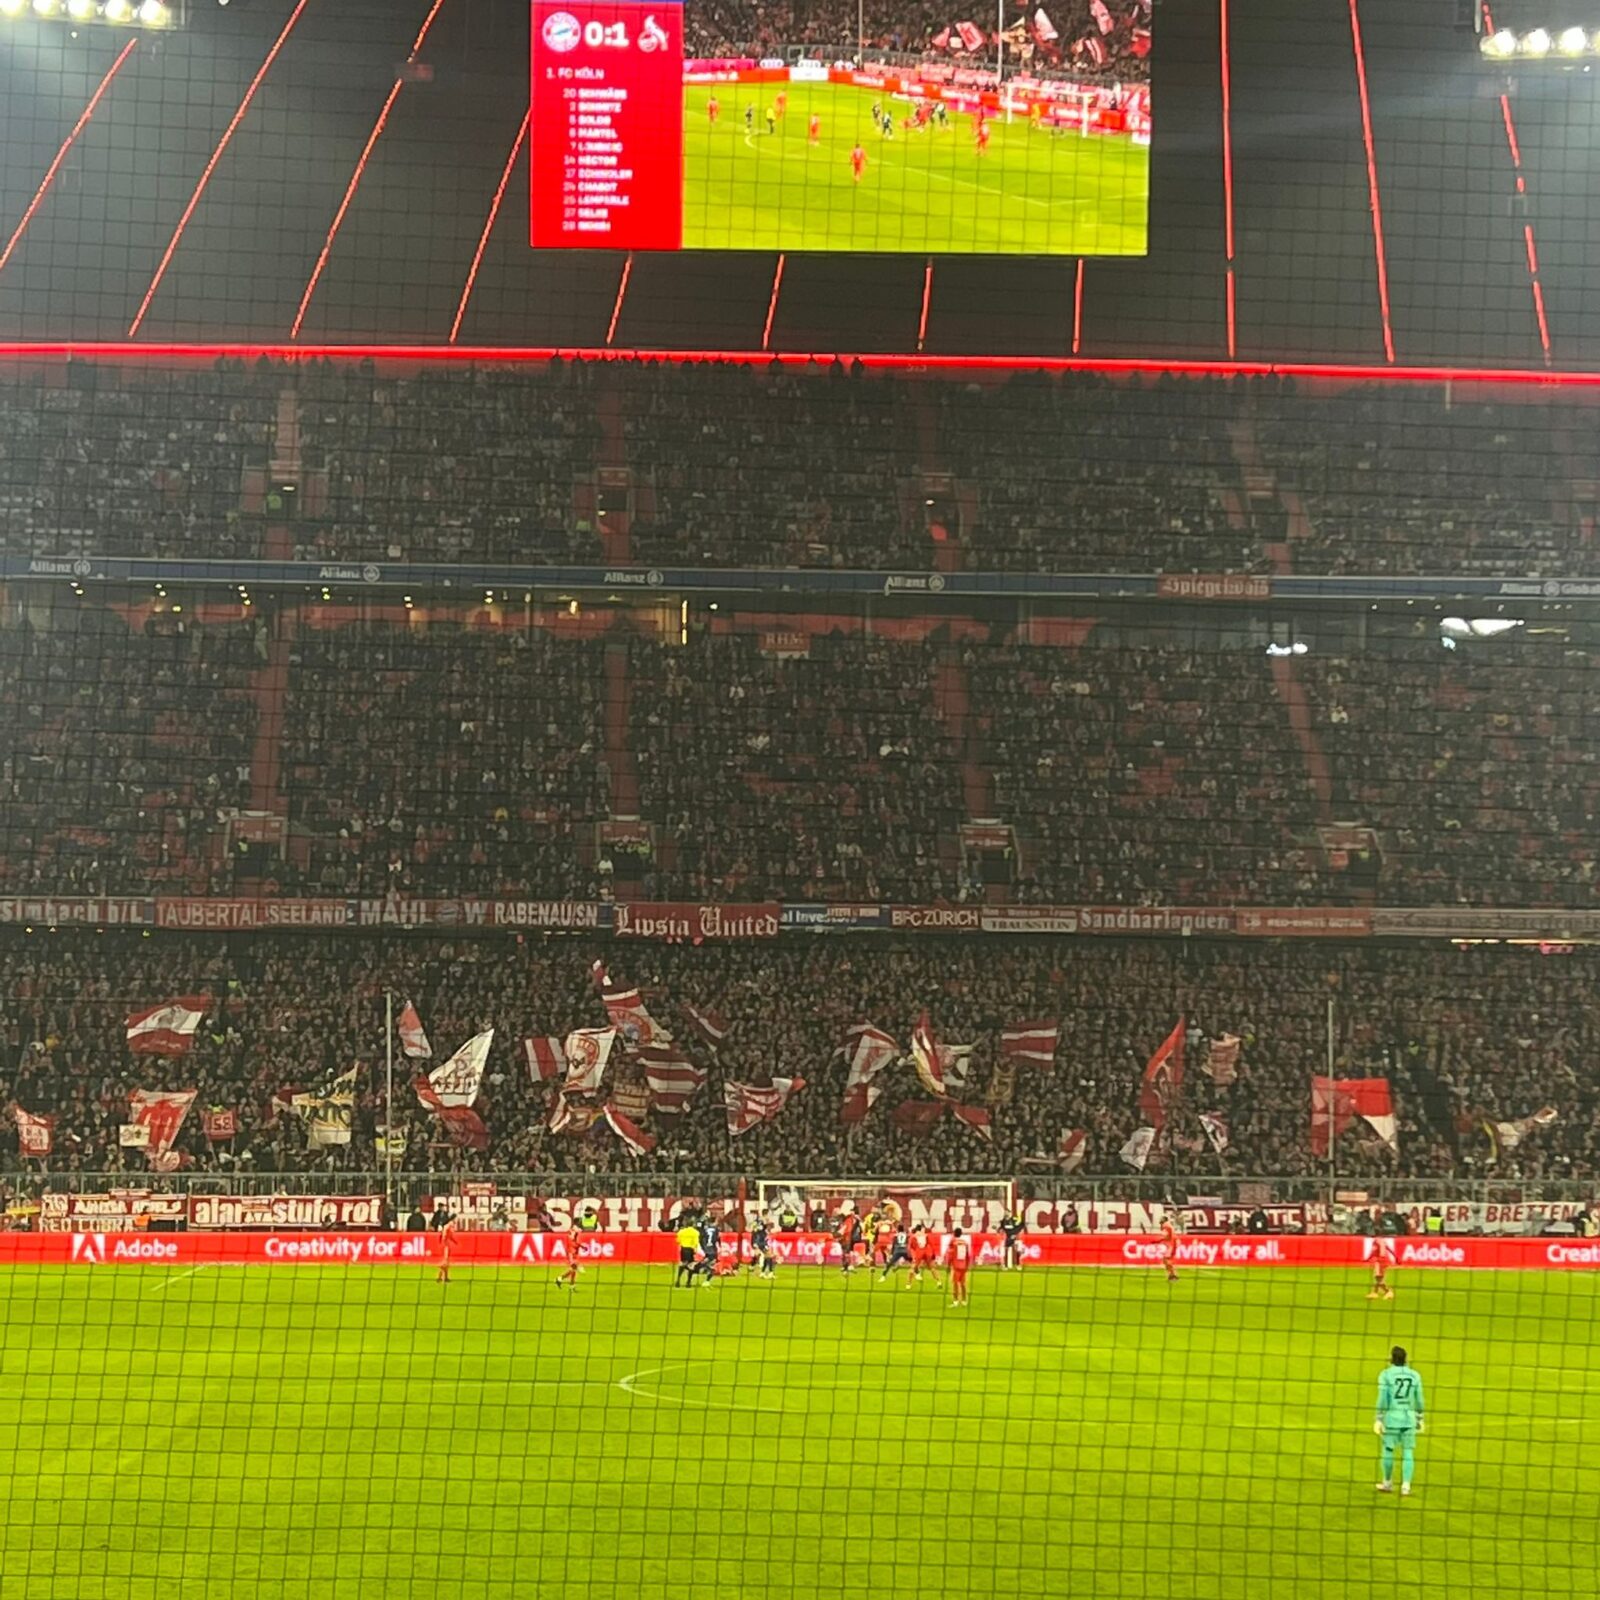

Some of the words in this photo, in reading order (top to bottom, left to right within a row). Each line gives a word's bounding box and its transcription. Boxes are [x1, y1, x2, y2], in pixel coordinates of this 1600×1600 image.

[584, 20, 630, 47] 0:1
[558, 67, 573, 79] FC
[575, 66, 605, 79] KÖLN
[28, 561, 72, 573] Allianz
[604, 571, 646, 584] Allianz
[884, 575, 927, 589] Allianz
[1499, 582, 1541, 595] Allianz
[158, 902, 263, 926] TAUBERTAL
[269, 903, 345, 925] SEELAND
[495, 902, 598, 927] RABENAU/SN
[613, 903, 690, 936] Lipsia
[700, 905, 778, 937] United
[892, 910, 922, 926] BFC
[923, 908, 979, 926] ZÜRICH
[342, 1198, 381, 1224] rot
[1486, 1204, 1578, 1222] BRETTEN
[38, 1218, 72, 1232] RED
[114, 1238, 179, 1257] Adobe
[264, 1237, 362, 1262] Creativity
[366, 1237, 397, 1257] for
[401, 1237, 432, 1257] all.
[552, 1239, 615, 1257] Aobe
[1122, 1239, 1218, 1264] Creaivity
[1222, 1239, 1251, 1259] for
[1255, 1239, 1286, 1260] all.
[1403, 1243, 1465, 1262] Adobe
[1394, 1377, 1413, 1399] 27
